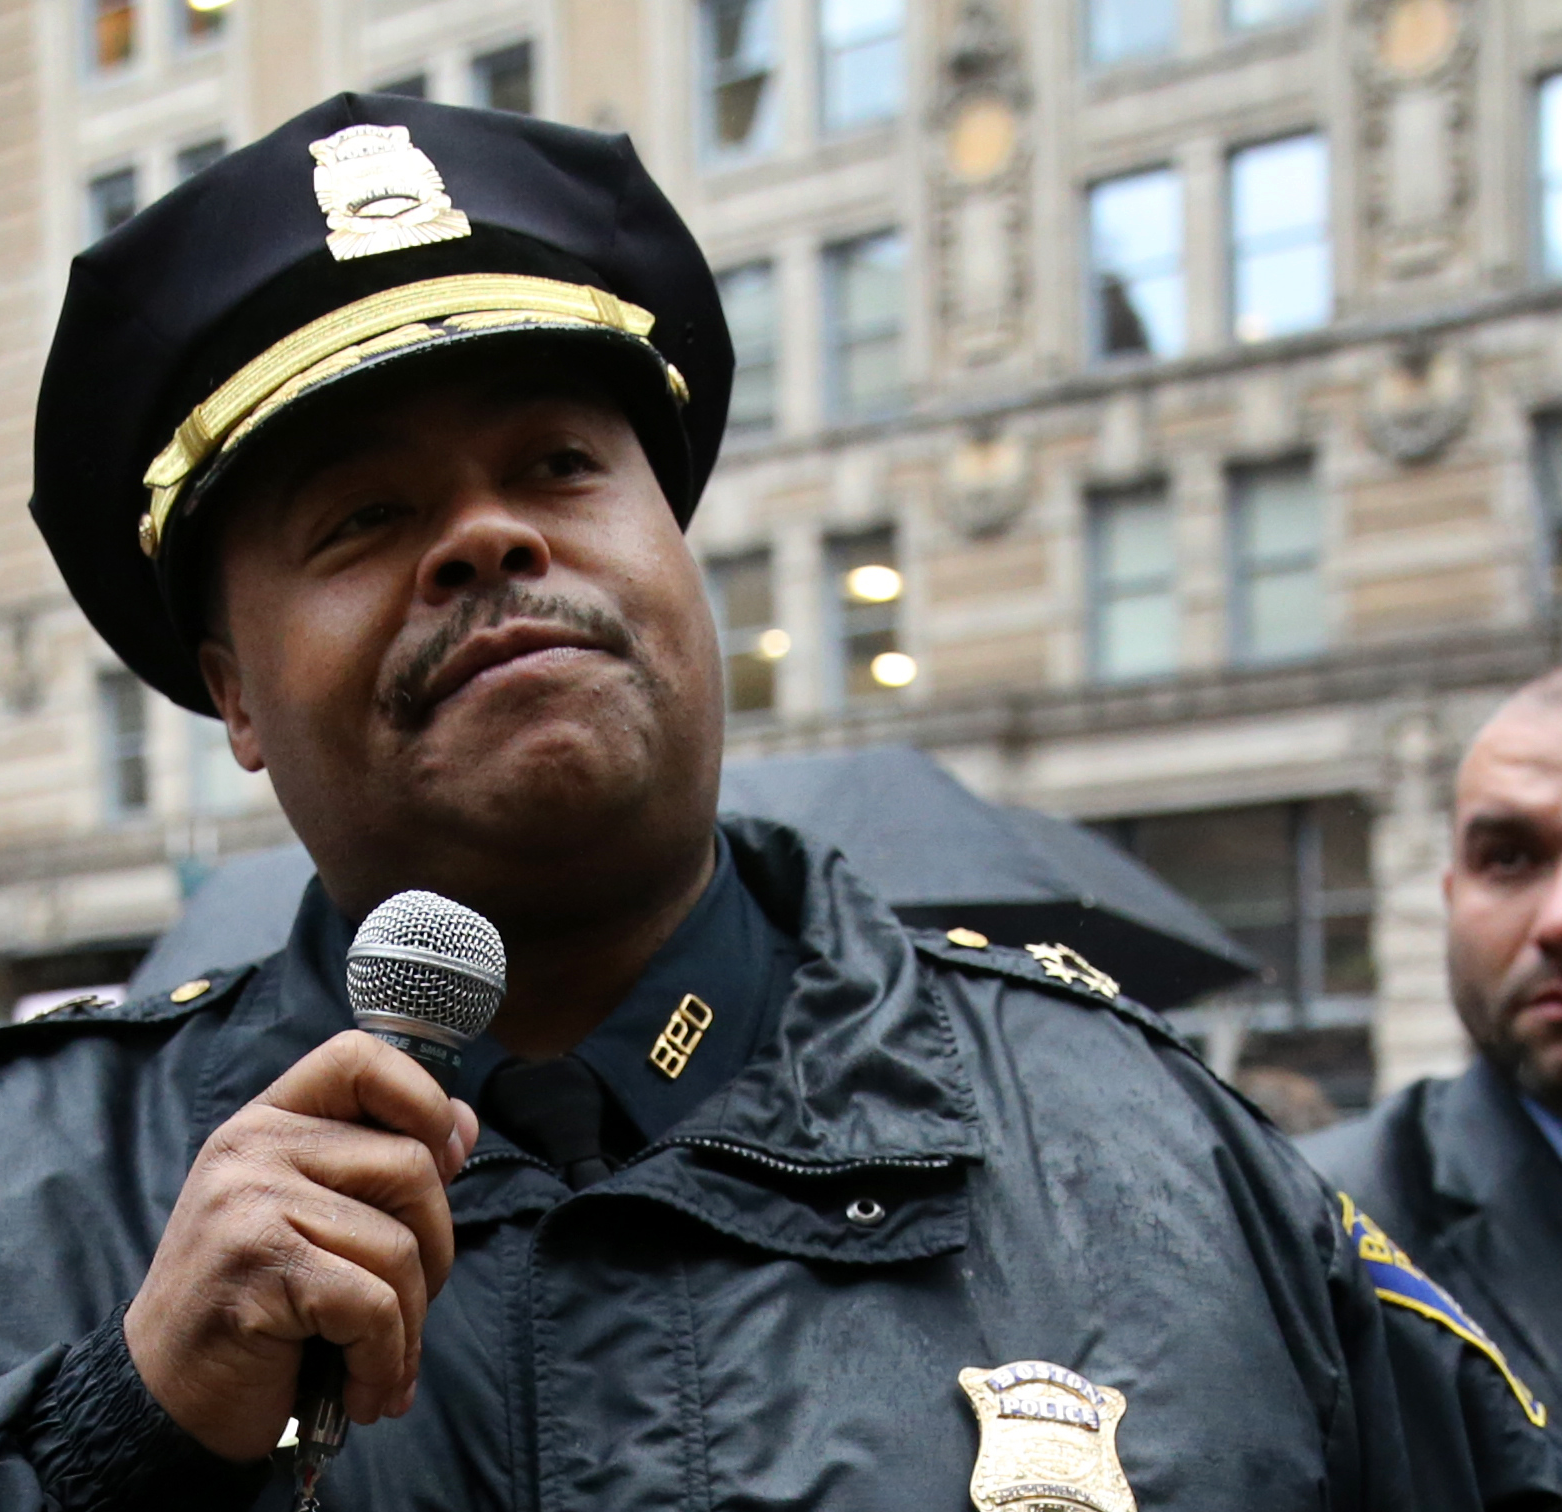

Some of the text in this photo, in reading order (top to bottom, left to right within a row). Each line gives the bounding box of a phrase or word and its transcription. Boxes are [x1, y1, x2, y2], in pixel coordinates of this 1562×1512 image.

[650, 993, 714, 1079] BPD
[997, 1363, 1102, 1405] BOSTON
[1002, 1398, 1098, 1425] POLICE
